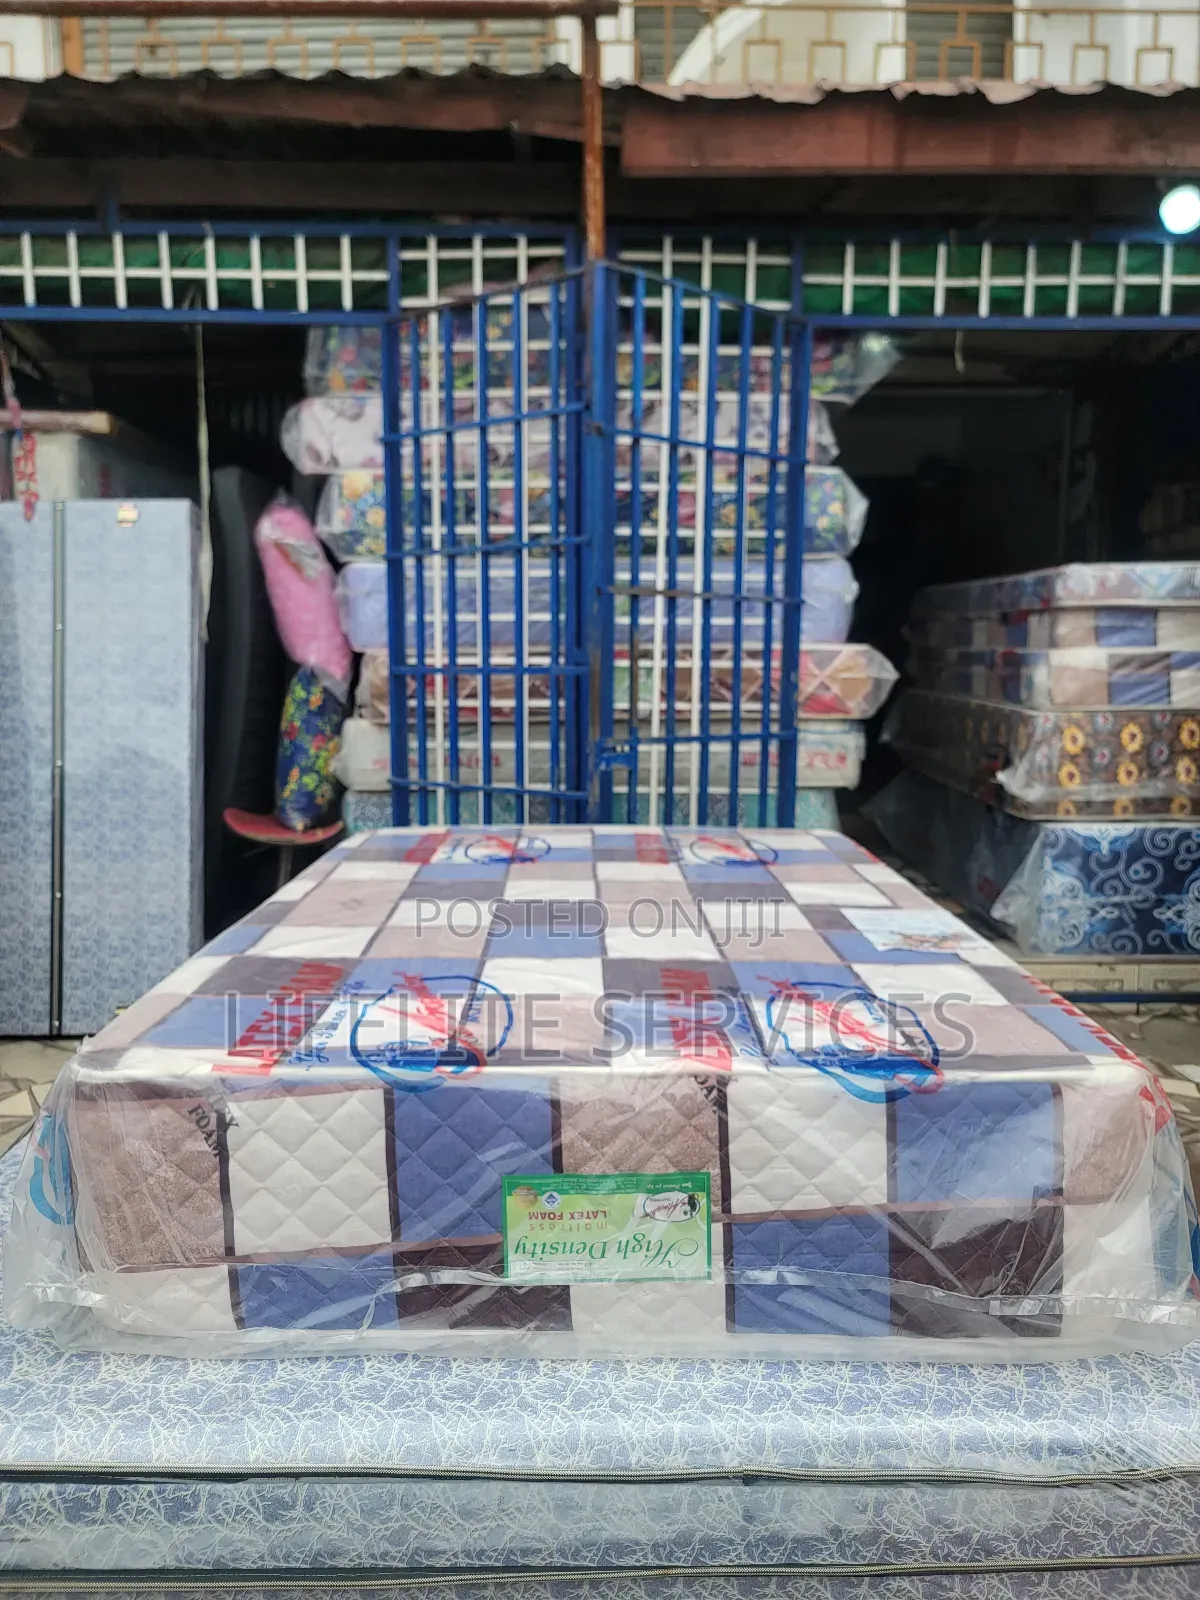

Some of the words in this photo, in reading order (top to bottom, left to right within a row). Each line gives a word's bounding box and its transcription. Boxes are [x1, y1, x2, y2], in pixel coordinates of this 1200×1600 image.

[528, 1210, 564, 1221] FOAM
[569, 1210, 608, 1220] LATEX
[528, 1221, 608, 1232] mattress
[514, 1235, 608, 1261] Density
[616, 1232, 699, 1269] High
